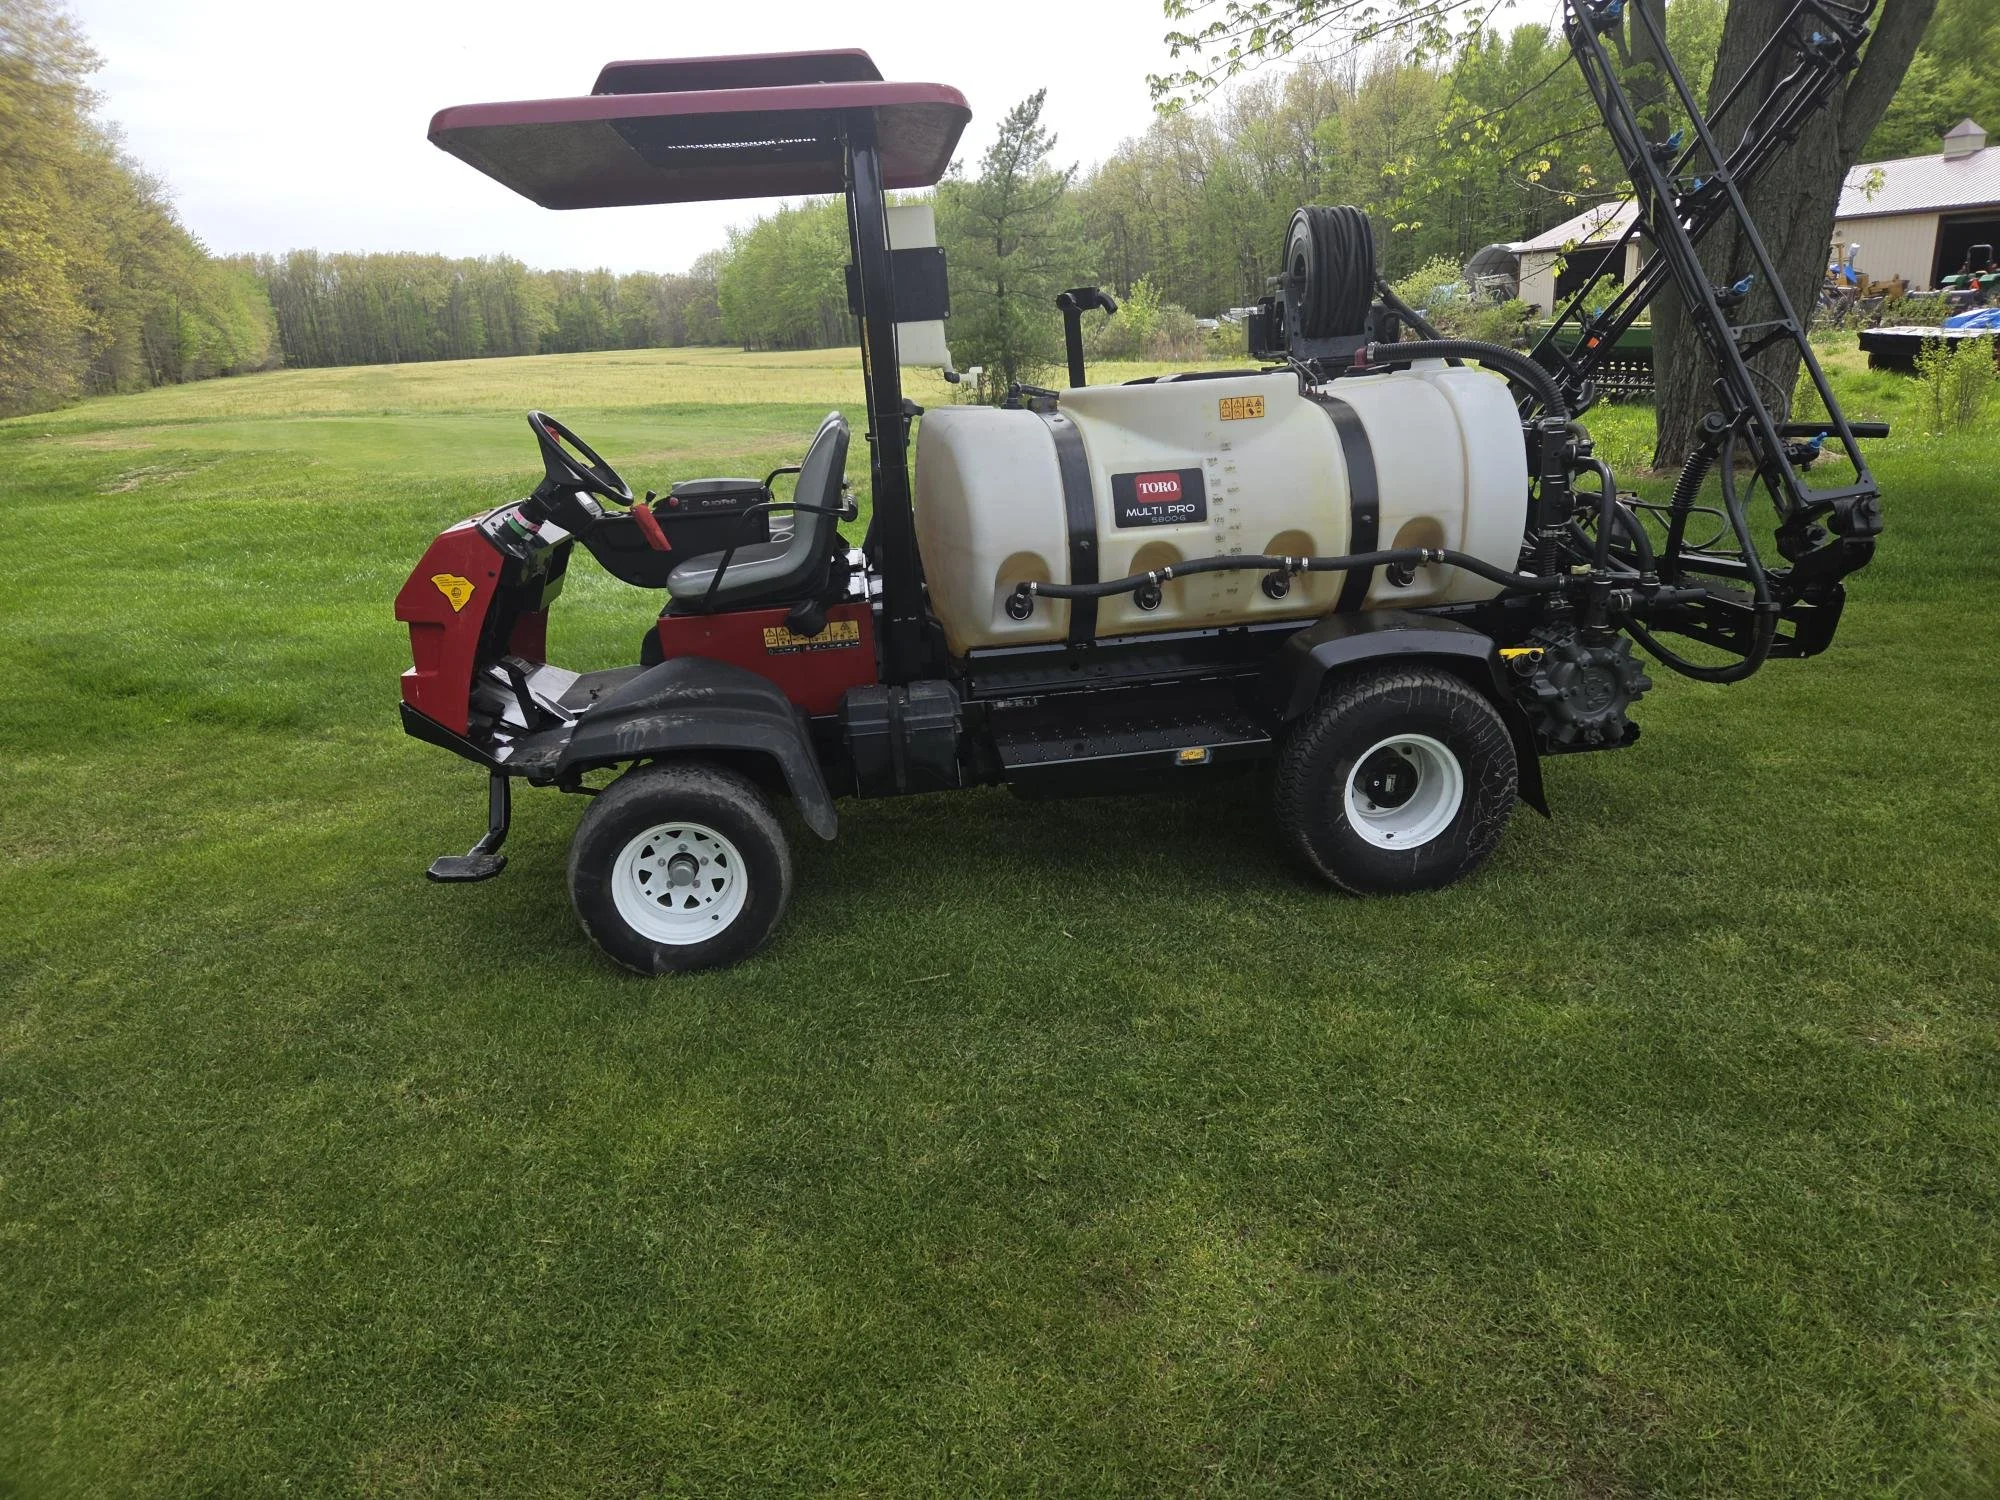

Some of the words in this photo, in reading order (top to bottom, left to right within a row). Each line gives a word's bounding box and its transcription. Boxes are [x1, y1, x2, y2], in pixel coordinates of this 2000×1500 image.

[1139, 480, 1178, 494] TORO
[1125, 506, 1163, 517] MULTI
[1167, 503, 1196, 514] PRO
